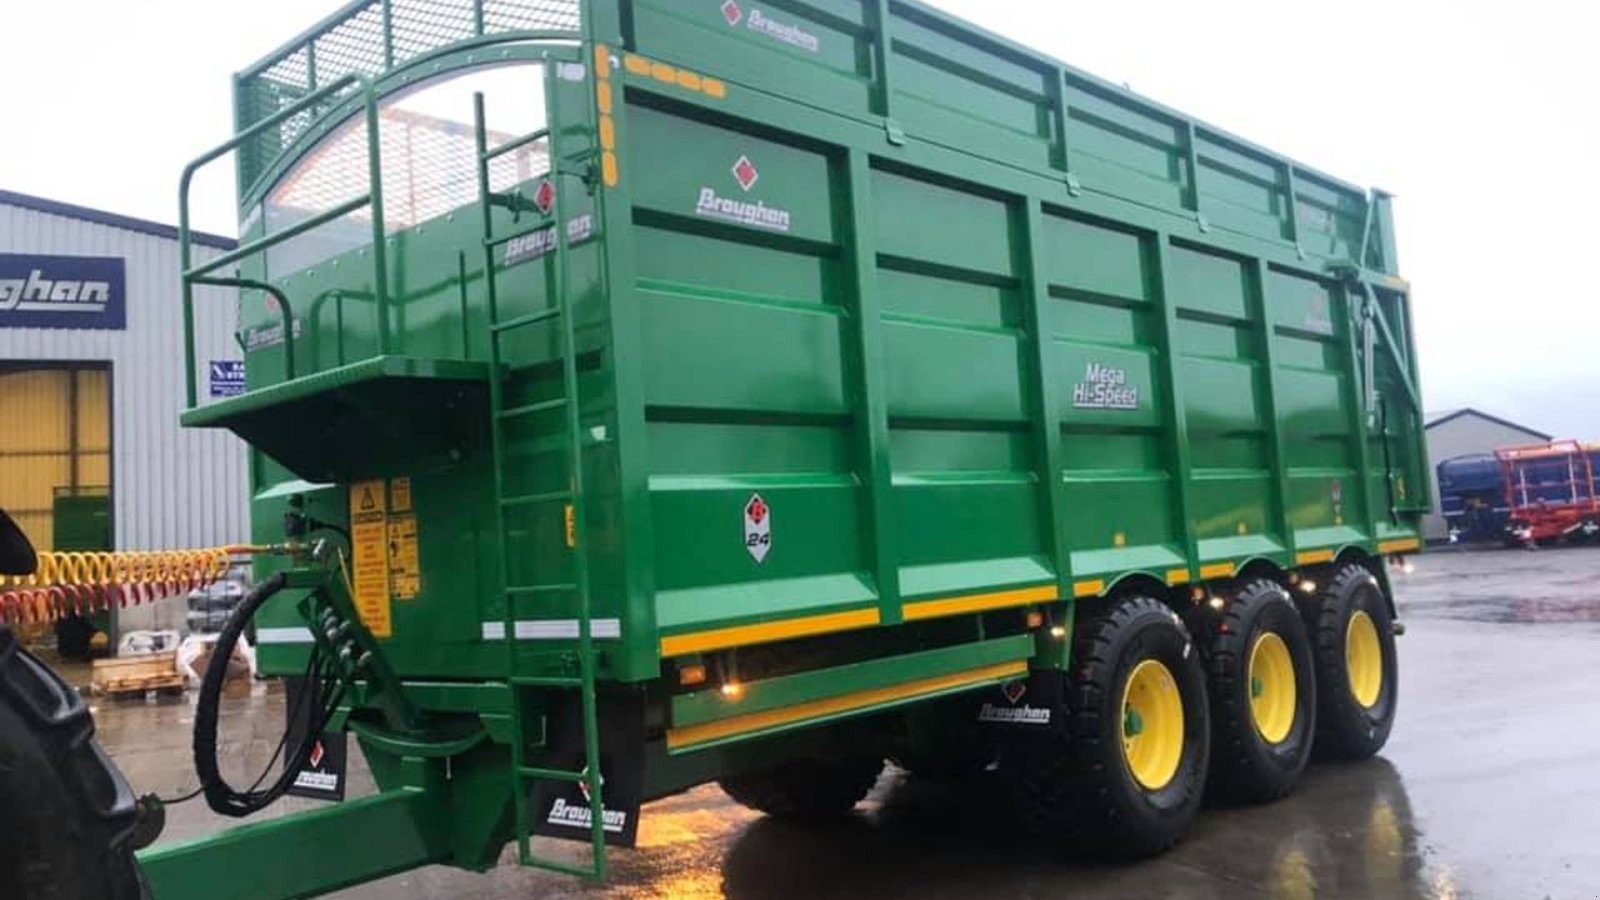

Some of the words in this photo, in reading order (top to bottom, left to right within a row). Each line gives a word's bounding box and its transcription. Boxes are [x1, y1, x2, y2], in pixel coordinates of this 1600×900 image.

[747, 9, 818, 52] Broughan
[697, 187, 790, 231] Broughan
[504, 213, 592, 267] Brougan
[1086, 362, 1125, 387] Mega
[1073, 383, 1137, 409] Hi-Speed
[747, 532, 770, 547] 24
[293, 767, 338, 790] roughan
[547, 798, 627, 832] Brouhan
